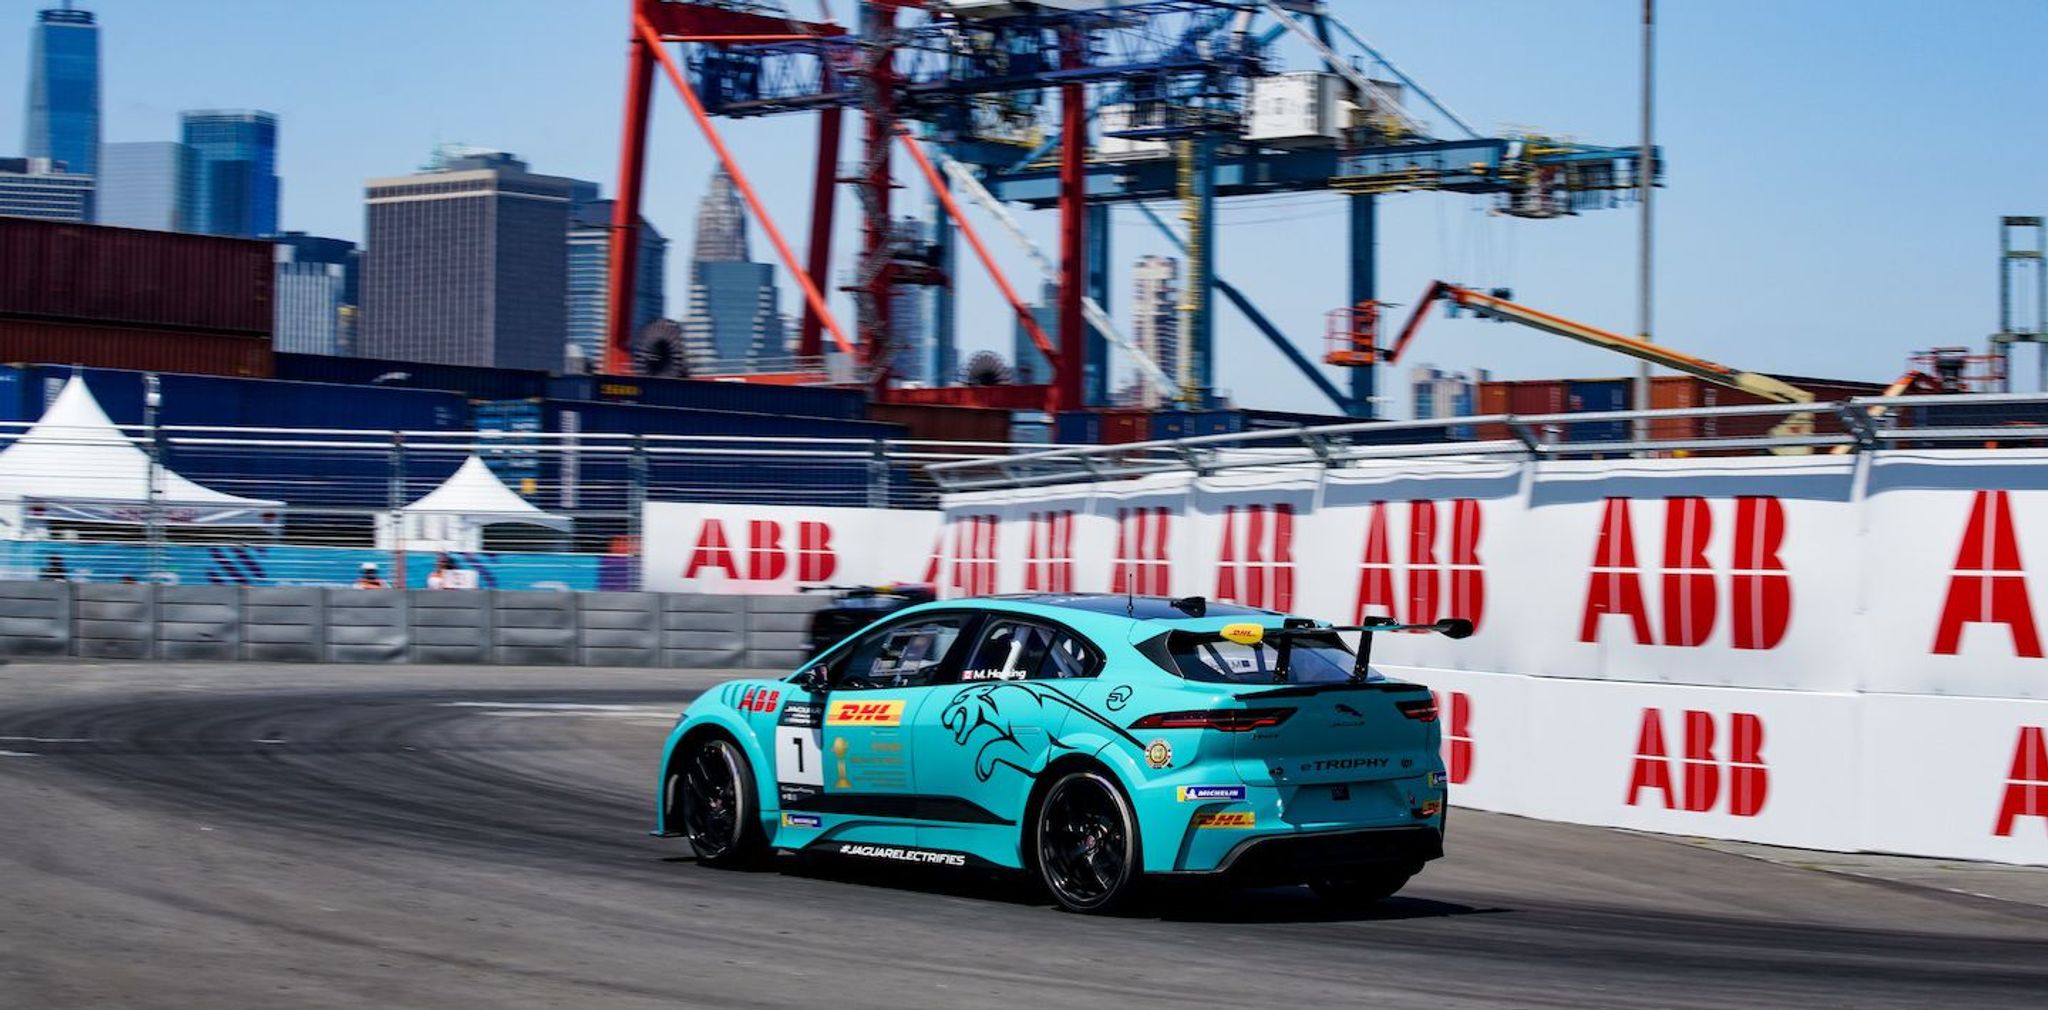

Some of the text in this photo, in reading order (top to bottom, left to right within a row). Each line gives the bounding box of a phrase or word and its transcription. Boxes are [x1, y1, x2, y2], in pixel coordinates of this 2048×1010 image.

[683, 519, 837, 581] ABB
[1111, 507, 1171, 597] ABB
[1215, 504, 1296, 614] ABB
[1355, 499, 1485, 635] ABB
[1578, 496, 1794, 650] ABB
[987, 668, 1027, 680] Hoing
[737, 690, 780, 712] ABB
[838, 704, 891, 721] DHL
[793, 737, 804, 773] 1
[1624, 708, 1769, 817] ABB
[1198, 789, 1239, 797] MICHELIN
[1197, 814, 1246, 825] DHL
[840, 844, 966, 866] #JAGUARELECTRIFIES
